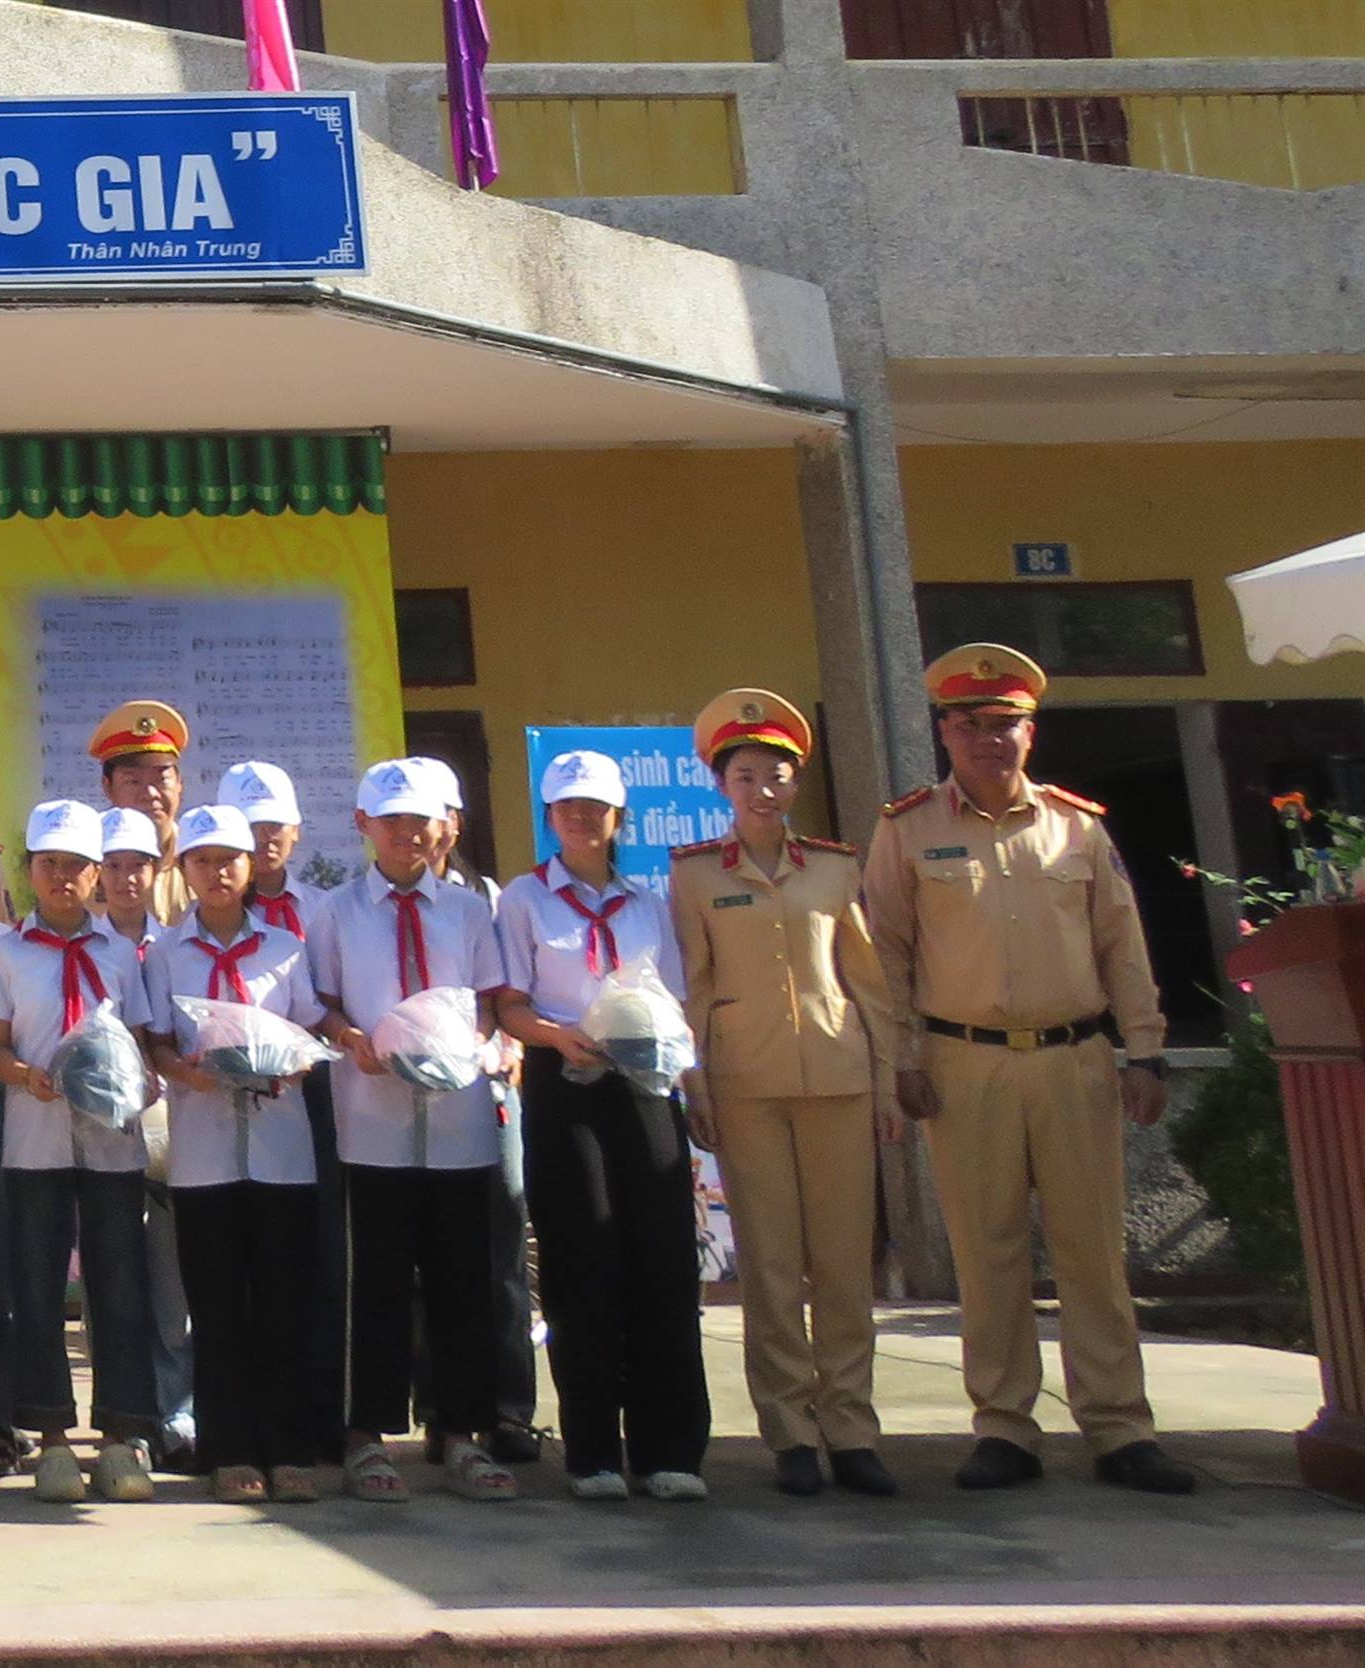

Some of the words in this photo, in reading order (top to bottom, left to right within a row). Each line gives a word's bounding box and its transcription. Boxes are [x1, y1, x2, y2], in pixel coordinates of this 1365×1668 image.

[68, 243, 122, 259] Thân
[129, 241, 187, 258] Nhân
[196, 240, 261, 260] Trung
[621, 749, 670, 787] sinh
[643, 800, 694, 847] điều
